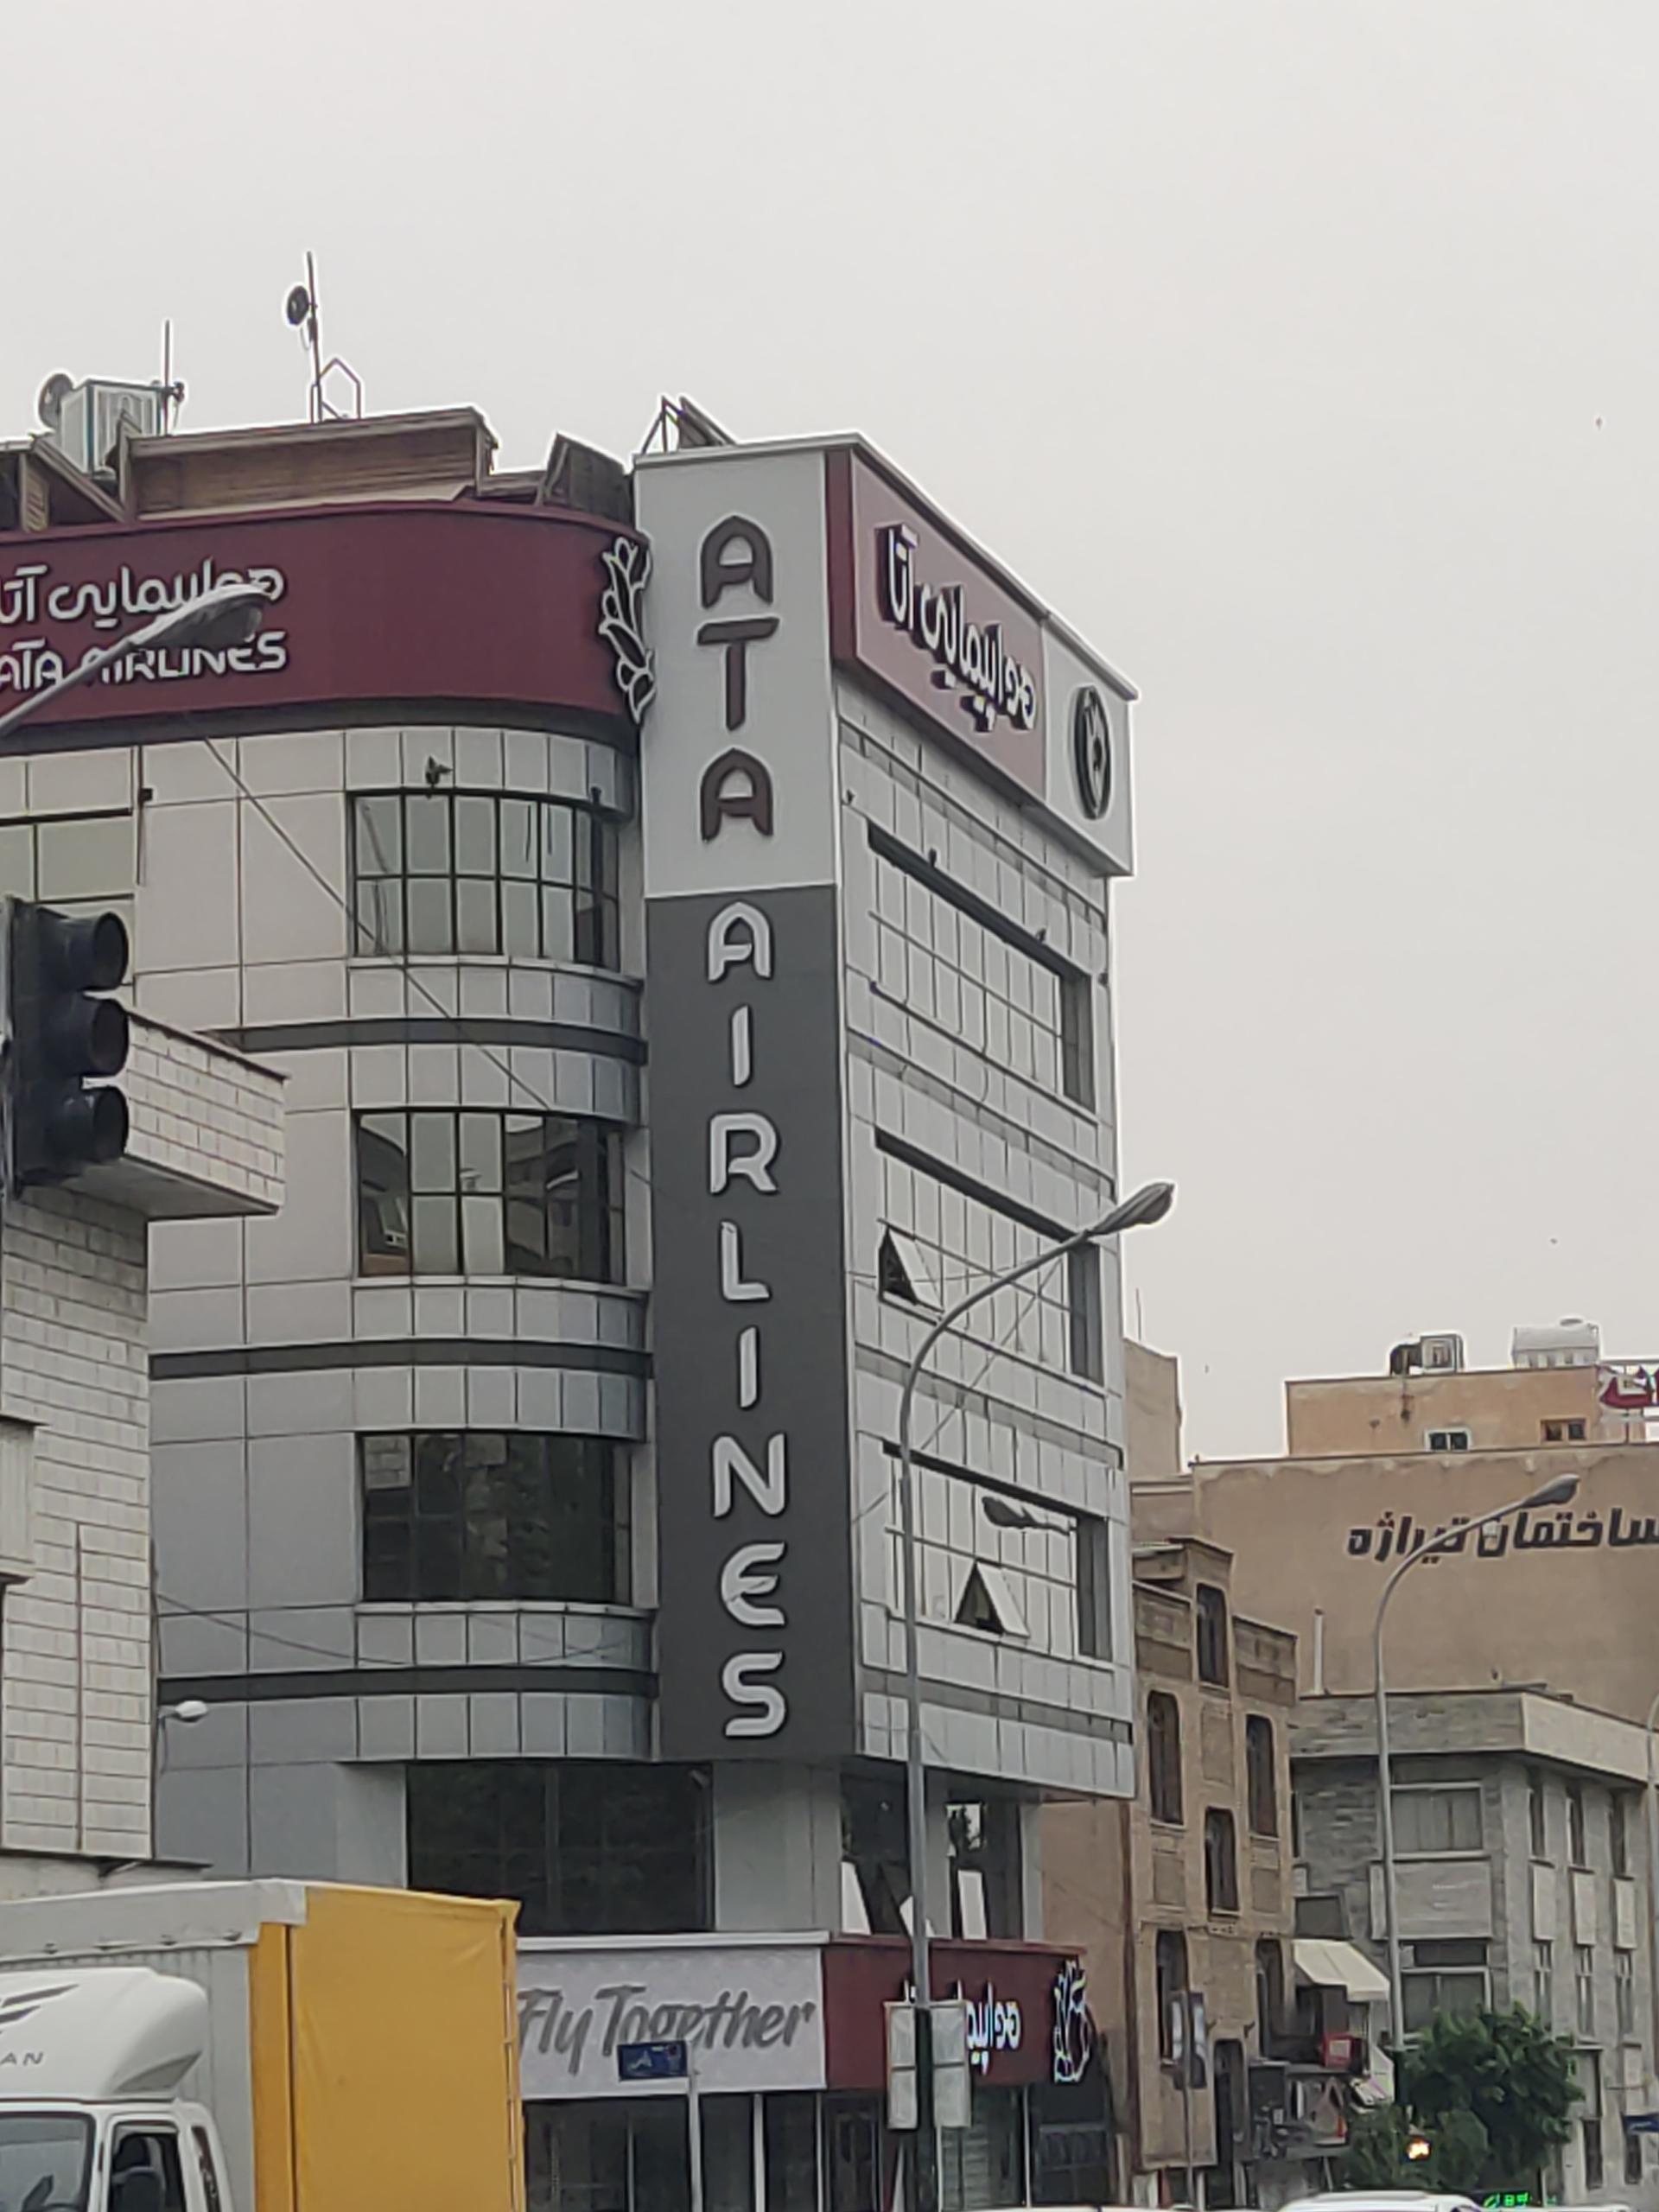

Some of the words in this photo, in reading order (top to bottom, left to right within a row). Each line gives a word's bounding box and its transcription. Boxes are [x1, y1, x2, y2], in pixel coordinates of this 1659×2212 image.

[875, 523, 918, 632] آتا
[696, 515, 779, 842] ATA
[911, 582, 1036, 733] هواپیمایی
[707, 900, 786, 1738] AIRLINES
[518, 1987, 594, 2076] Fly
[594, 1985, 817, 2056] Together
